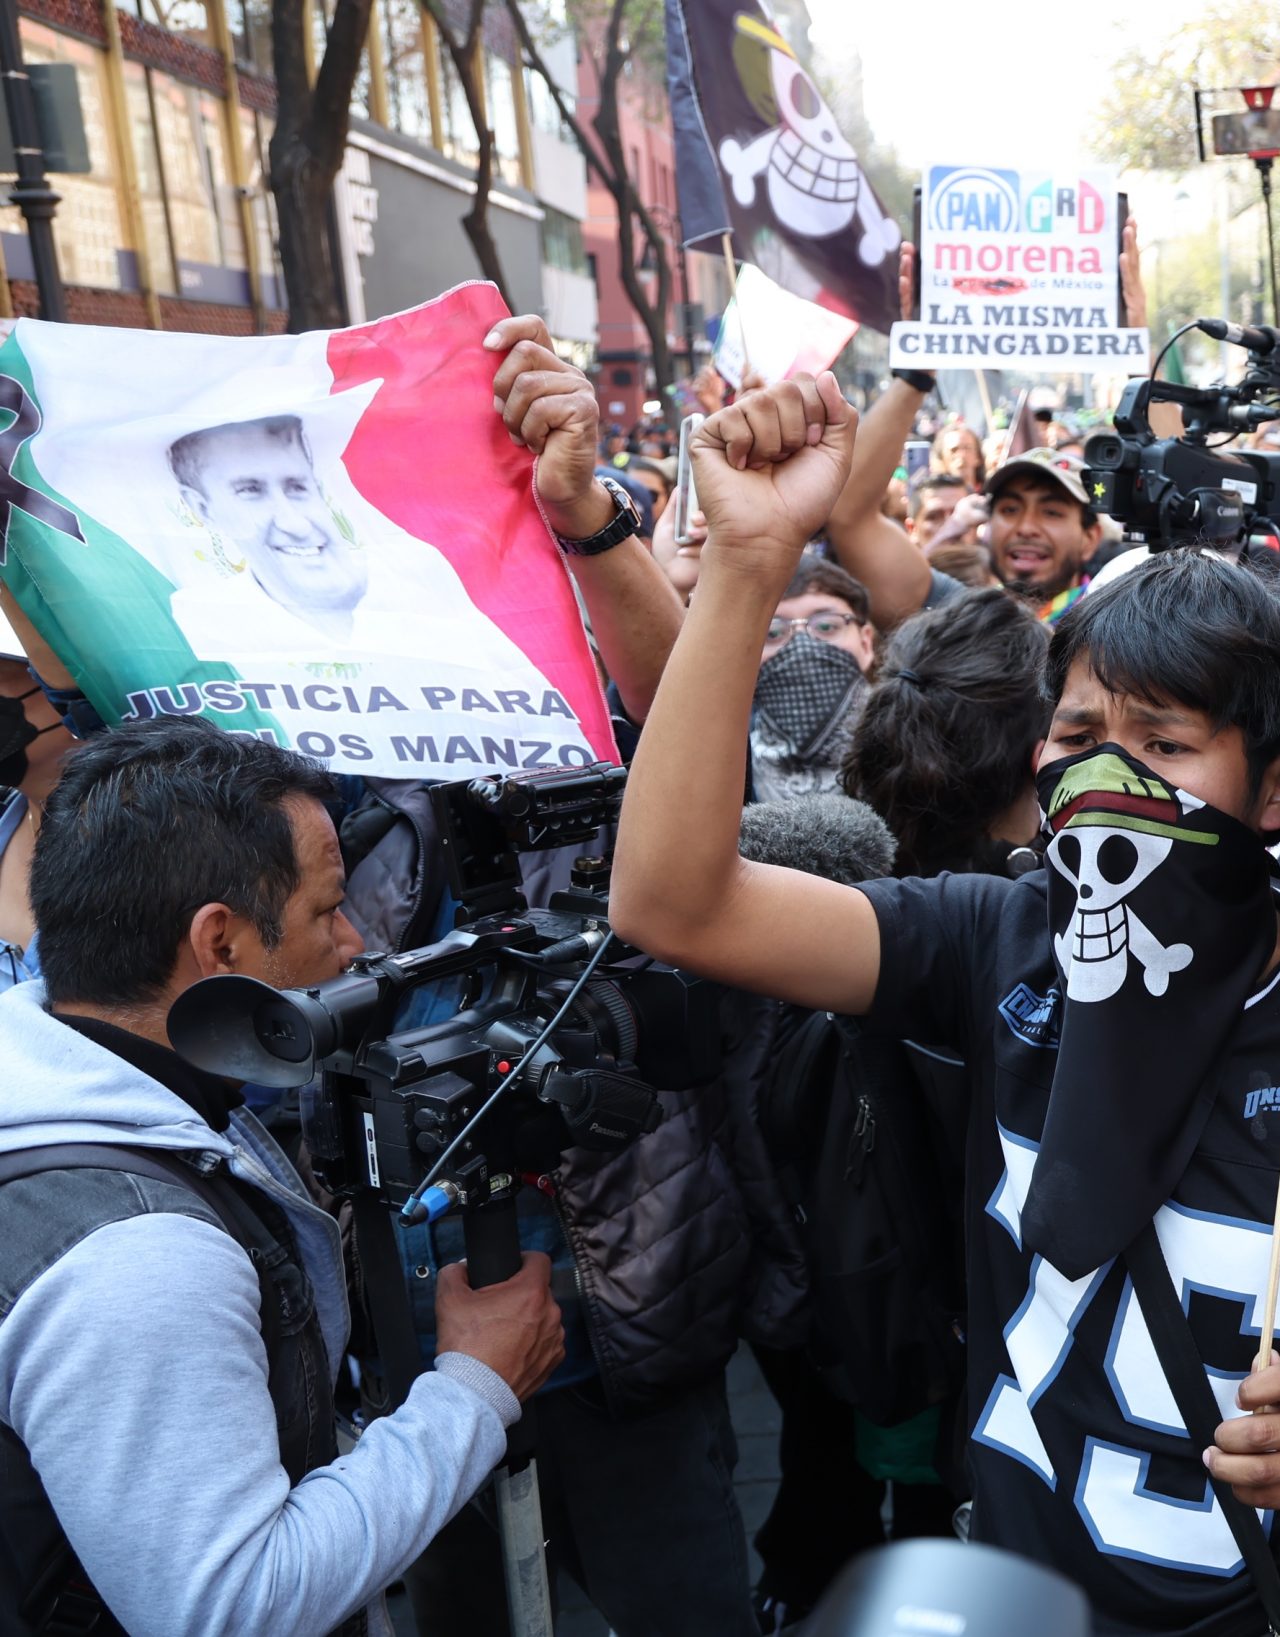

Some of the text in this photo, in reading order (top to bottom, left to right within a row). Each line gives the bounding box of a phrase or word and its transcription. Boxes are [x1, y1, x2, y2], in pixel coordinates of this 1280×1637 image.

[948, 182, 1101, 233] PAN PRI
[934, 242, 1103, 274] morena
[933, 276, 948, 287] La
[1031, 276, 1047, 288] de
[929, 305, 1109, 328] LA MISMA
[898, 333, 1145, 356] CHINGADERA
[121, 681, 578, 721] JUSTICIA PARA
[389, 735, 594, 769] MANZO
